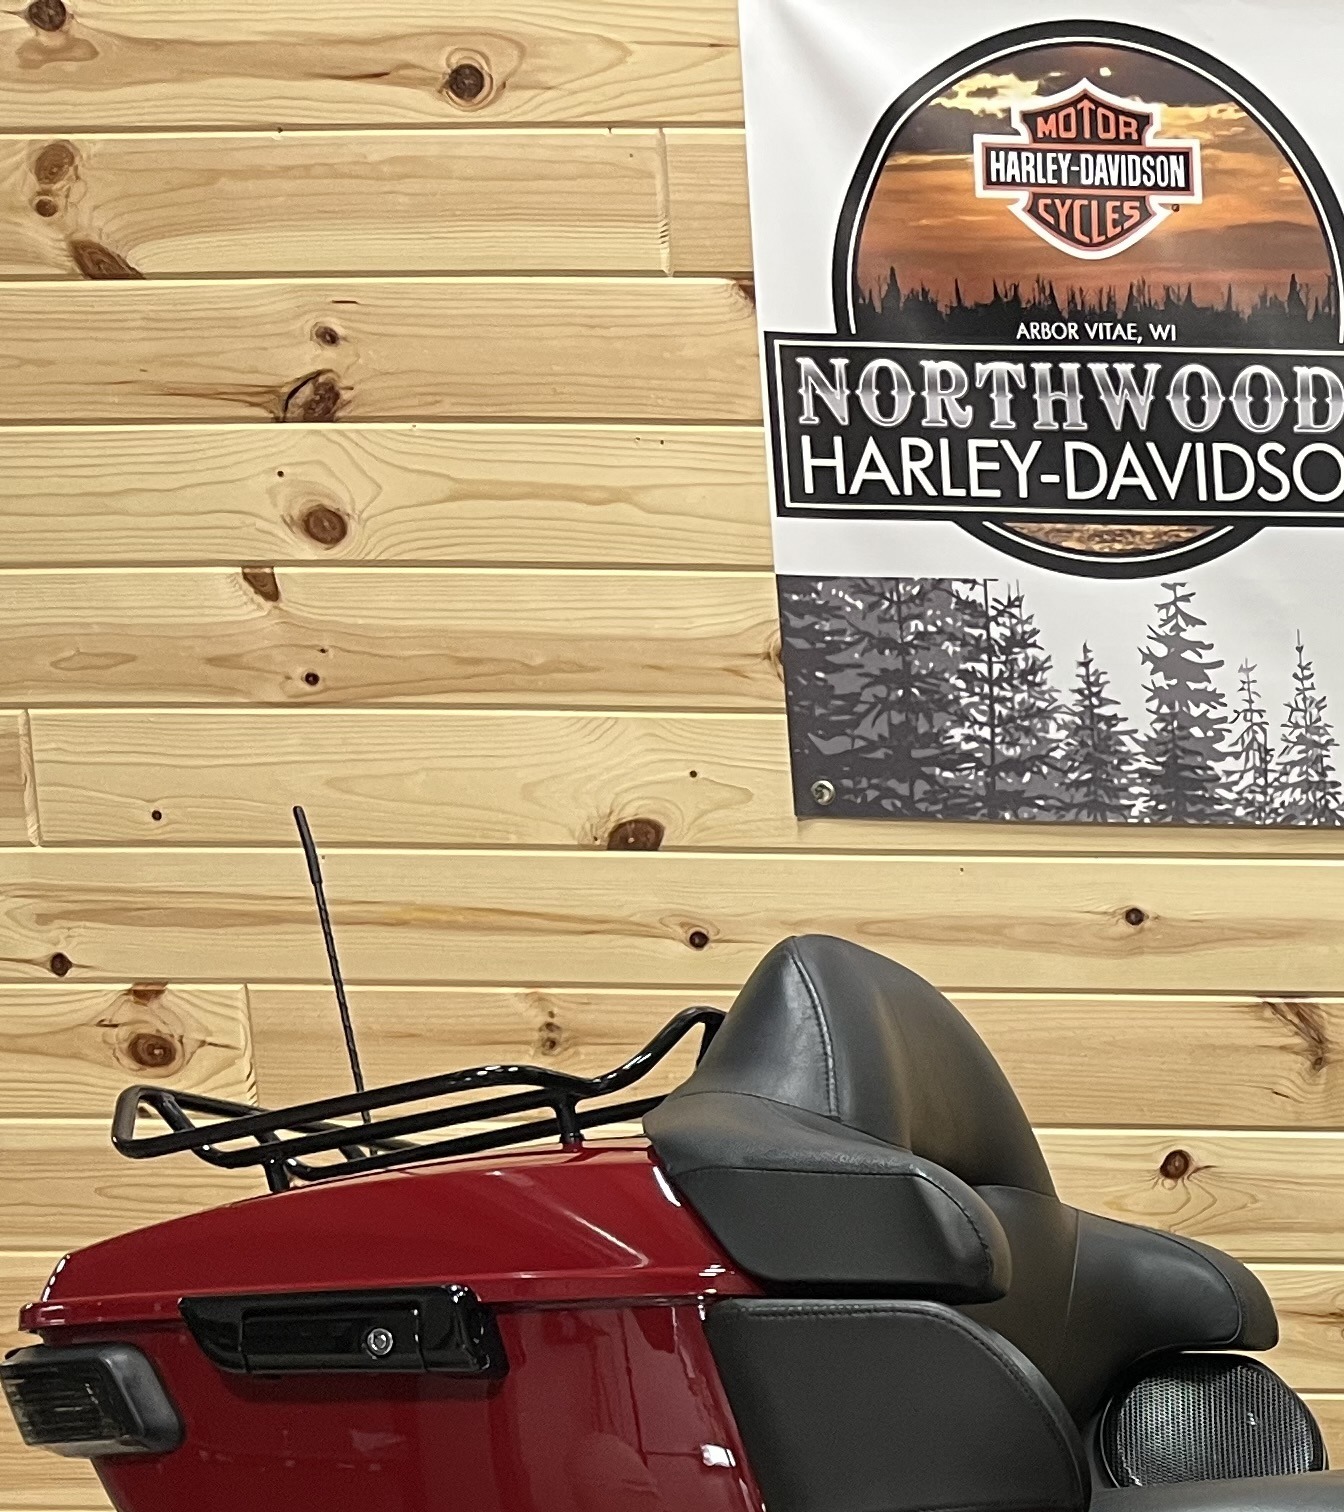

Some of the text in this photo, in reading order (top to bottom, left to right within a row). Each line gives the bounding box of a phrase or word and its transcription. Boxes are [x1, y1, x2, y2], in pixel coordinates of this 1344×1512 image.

[1036, 98, 1139, 140] MOTOR
[990, 150, 1186, 188] HARLEY-DAVIDSON
[1037, 198, 1141, 244] CYCLES
[1015, 321, 1178, 345] ARBOR VITAE, WI
